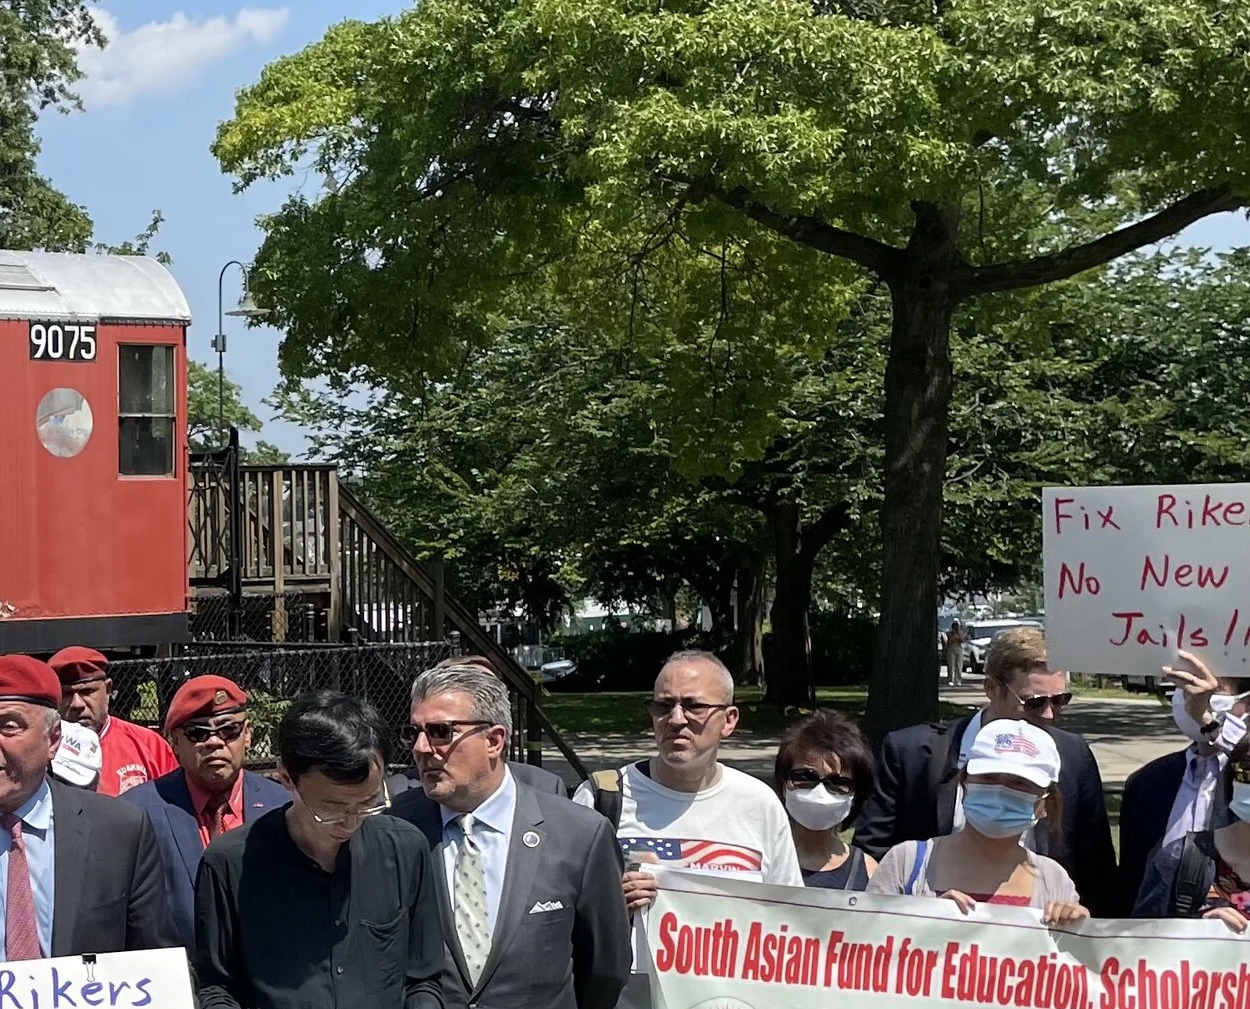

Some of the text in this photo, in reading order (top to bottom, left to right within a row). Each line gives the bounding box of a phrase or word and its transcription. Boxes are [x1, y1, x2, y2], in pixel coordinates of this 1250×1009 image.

[31, 324, 96, 360] 9075
[1055, 497, 1121, 535] Fix
[1058, 553, 1229, 600] No New
[656, 912, 739, 978] South
[742, 922, 820, 986] Asian
[824, 930, 894, 992] Fund
[895, 937, 938, 997] for
